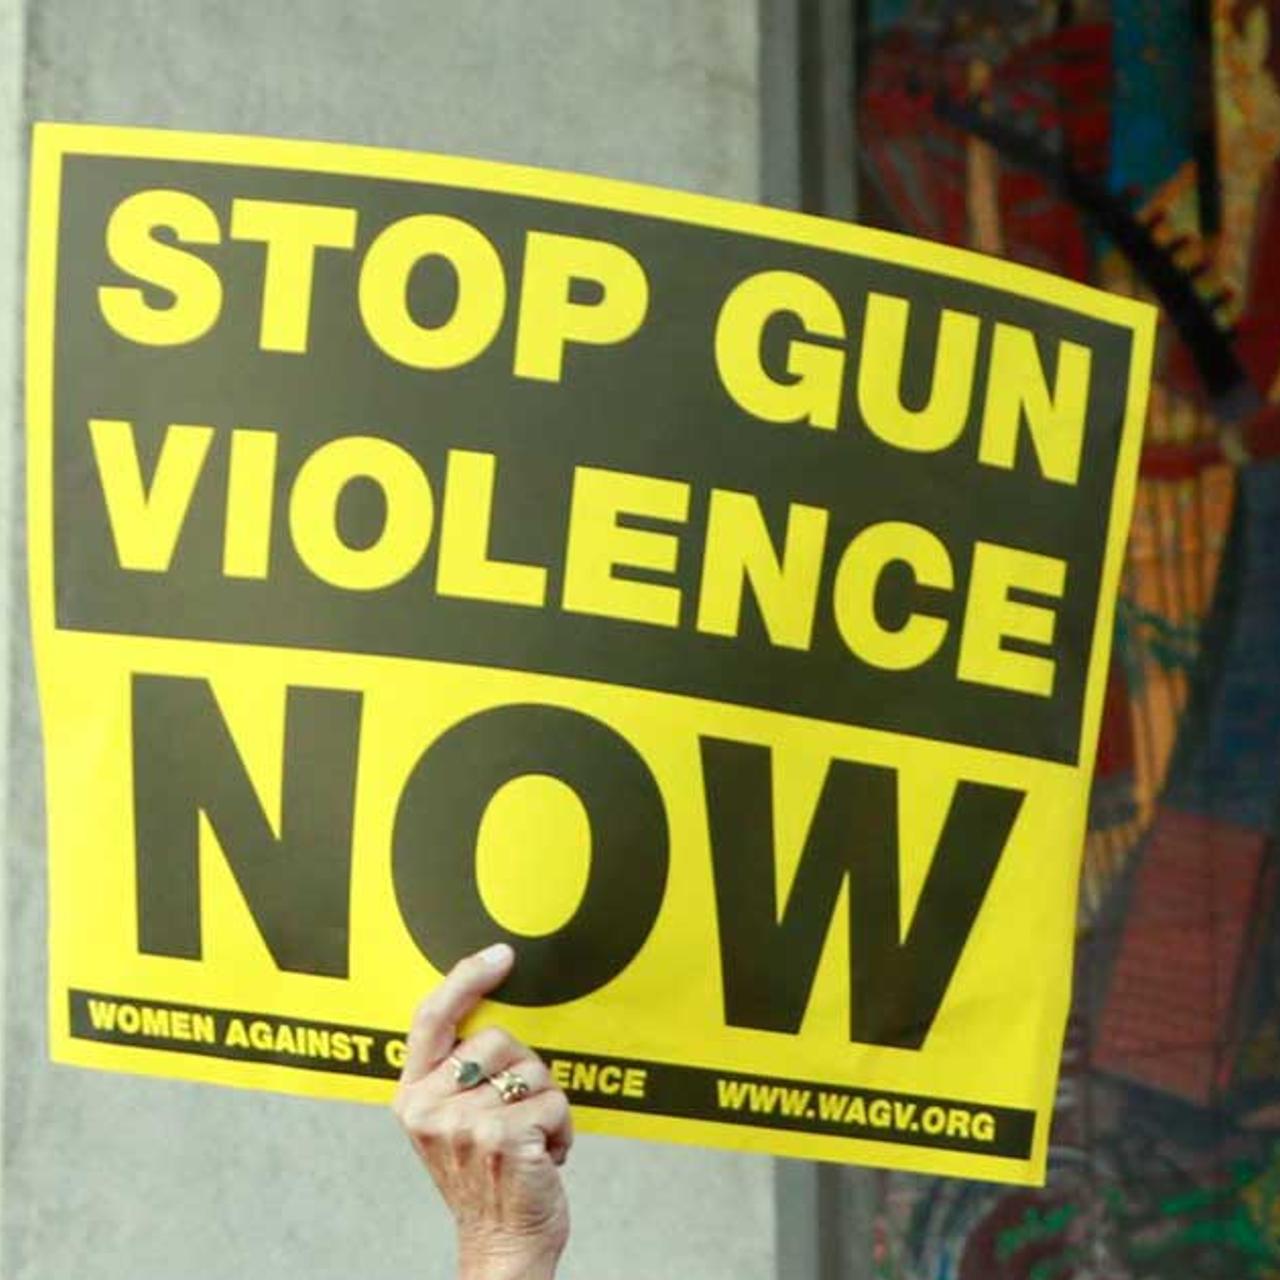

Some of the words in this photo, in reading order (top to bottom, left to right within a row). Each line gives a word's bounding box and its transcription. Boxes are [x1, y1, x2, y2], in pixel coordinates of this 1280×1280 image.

[97, 189, 649, 383] STOP
[715, 270, 1091, 485] GUN
[87, 418, 1067, 697] VIOLENCE
[130, 670, 1028, 1052] NOW
[88, 999, 216, 1044] WOMEN
[225, 1018, 374, 1063] AGAINST
[552, 1060, 647, 1097] ENCE
[717, 1079, 996, 1141] WWW.WAGV.ORG
